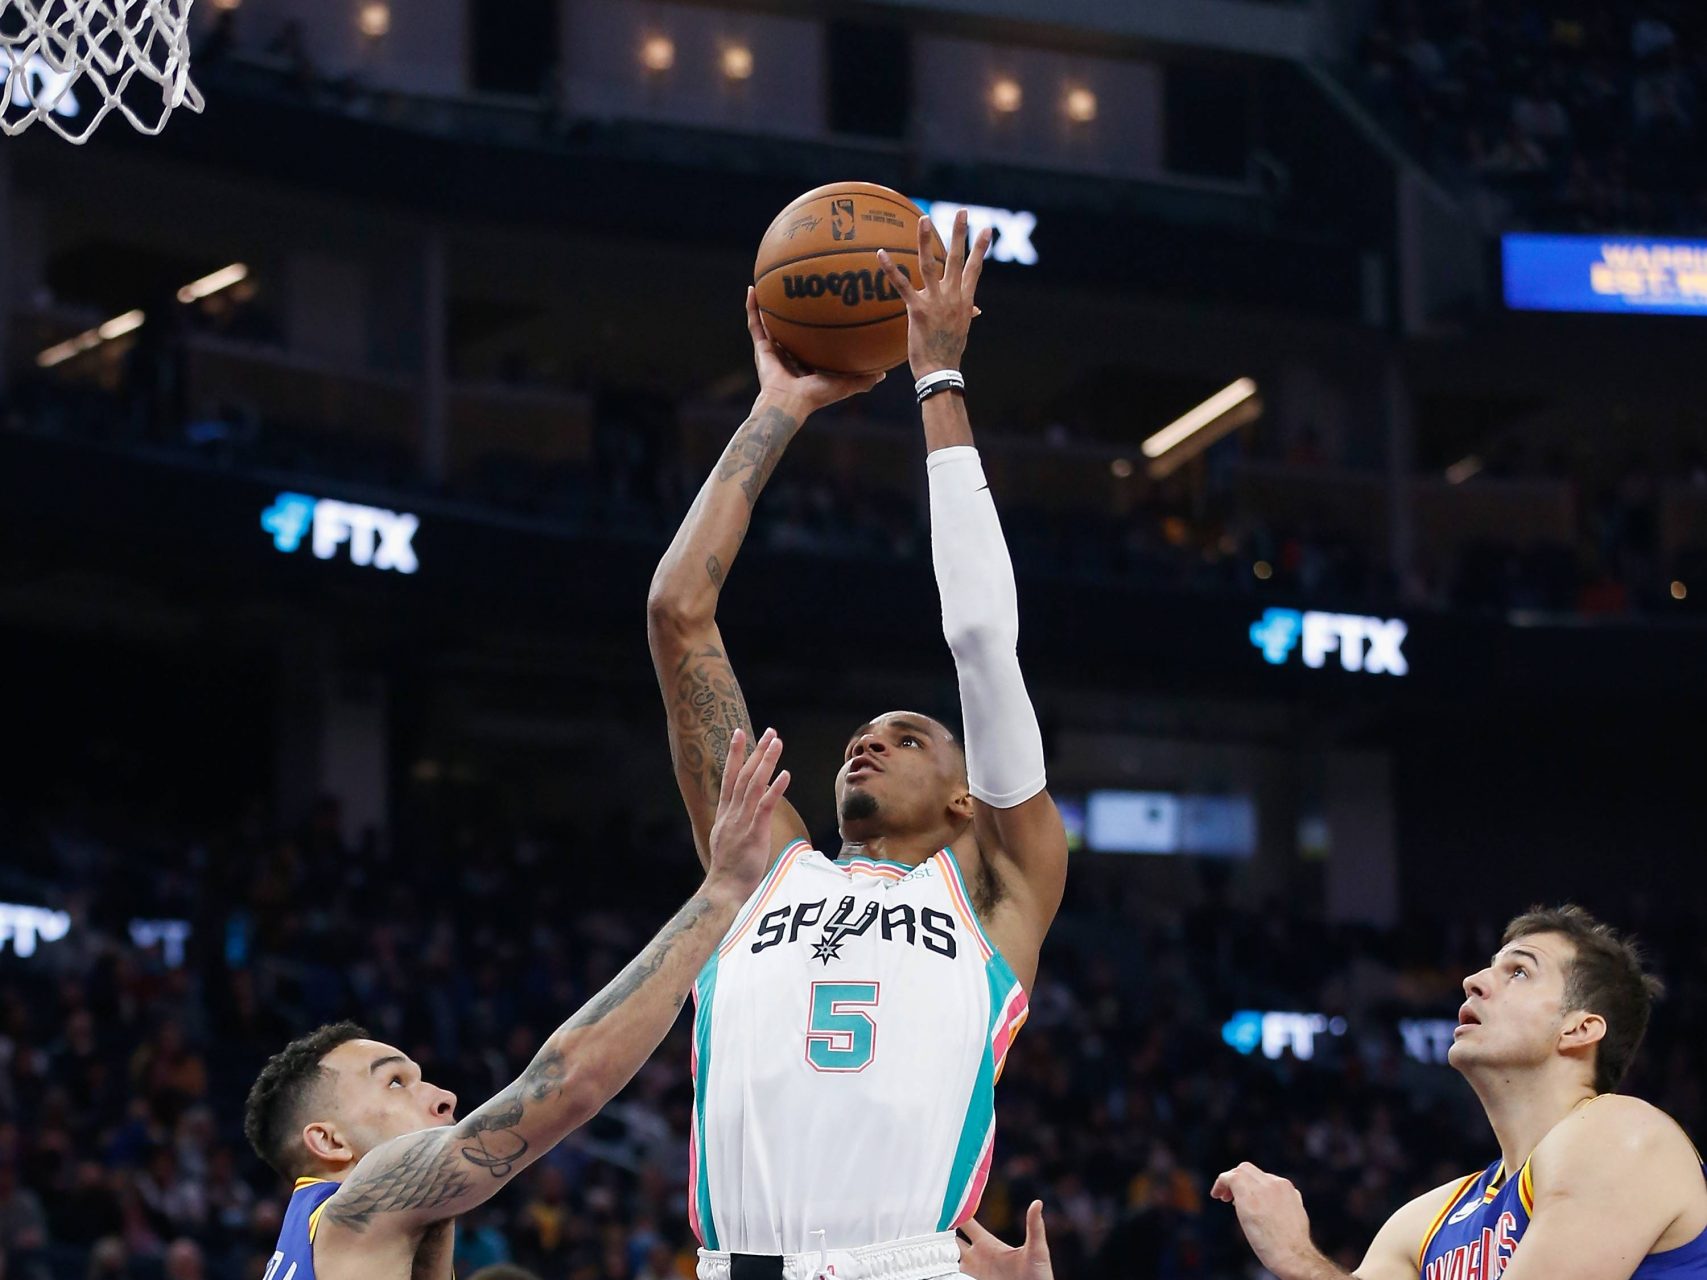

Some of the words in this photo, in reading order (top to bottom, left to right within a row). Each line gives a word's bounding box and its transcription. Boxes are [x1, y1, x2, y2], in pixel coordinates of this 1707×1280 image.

[783, 264, 911, 307] Wilson
[312, 498, 420, 574] FTX
[1302, 610, 1409, 677] FTX
[751, 895, 957, 965] SPURS
[805, 980, 880, 1073] 5
